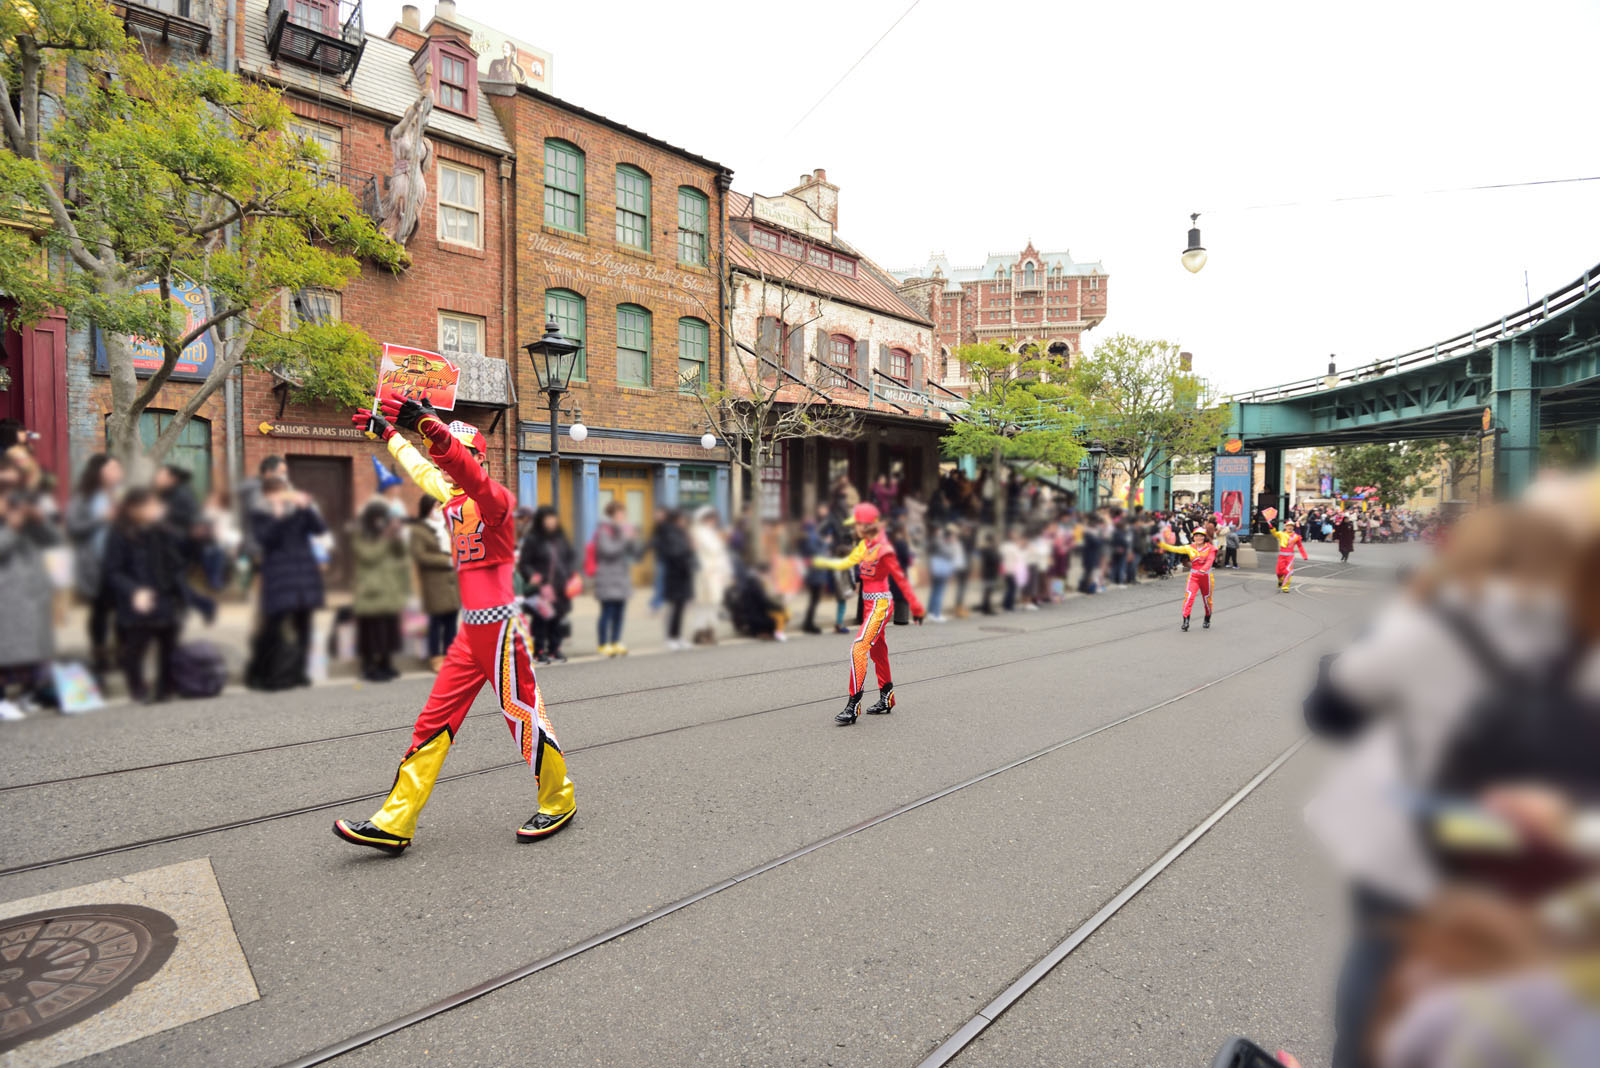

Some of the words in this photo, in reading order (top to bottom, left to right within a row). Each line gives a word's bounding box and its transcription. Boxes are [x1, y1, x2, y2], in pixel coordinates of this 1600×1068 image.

[528, 233, 586, 263] Madame
[444, 325, 458, 346] 25
[382, 368, 453, 391] VICTORY
[312, 427, 337, 436] ARMS
[339, 428, 363, 437] HOTEL
[456, 533, 485, 562] 95
